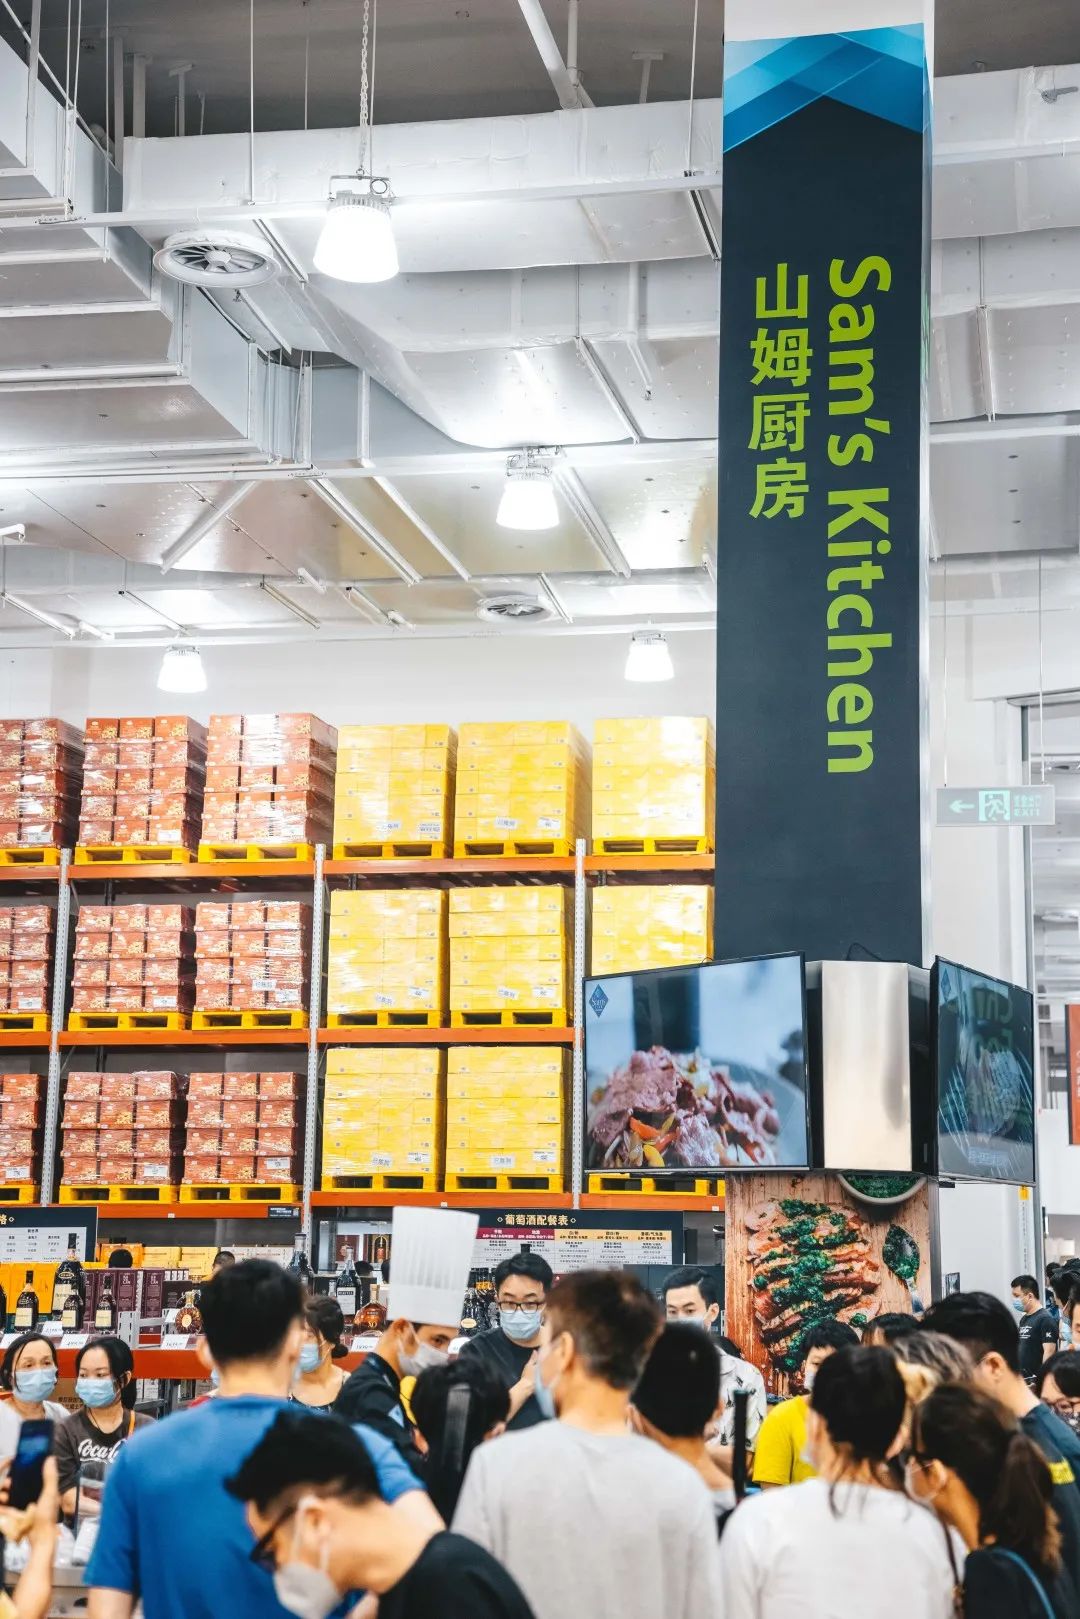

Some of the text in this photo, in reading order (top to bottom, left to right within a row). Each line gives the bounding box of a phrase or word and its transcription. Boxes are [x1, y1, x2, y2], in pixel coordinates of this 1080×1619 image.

[747, 262, 814, 520] 山姆厨房
[826, 255, 893, 774] Sam’s Kitchen
[504, 1213, 569, 1226] 葡萄酒配餐表
